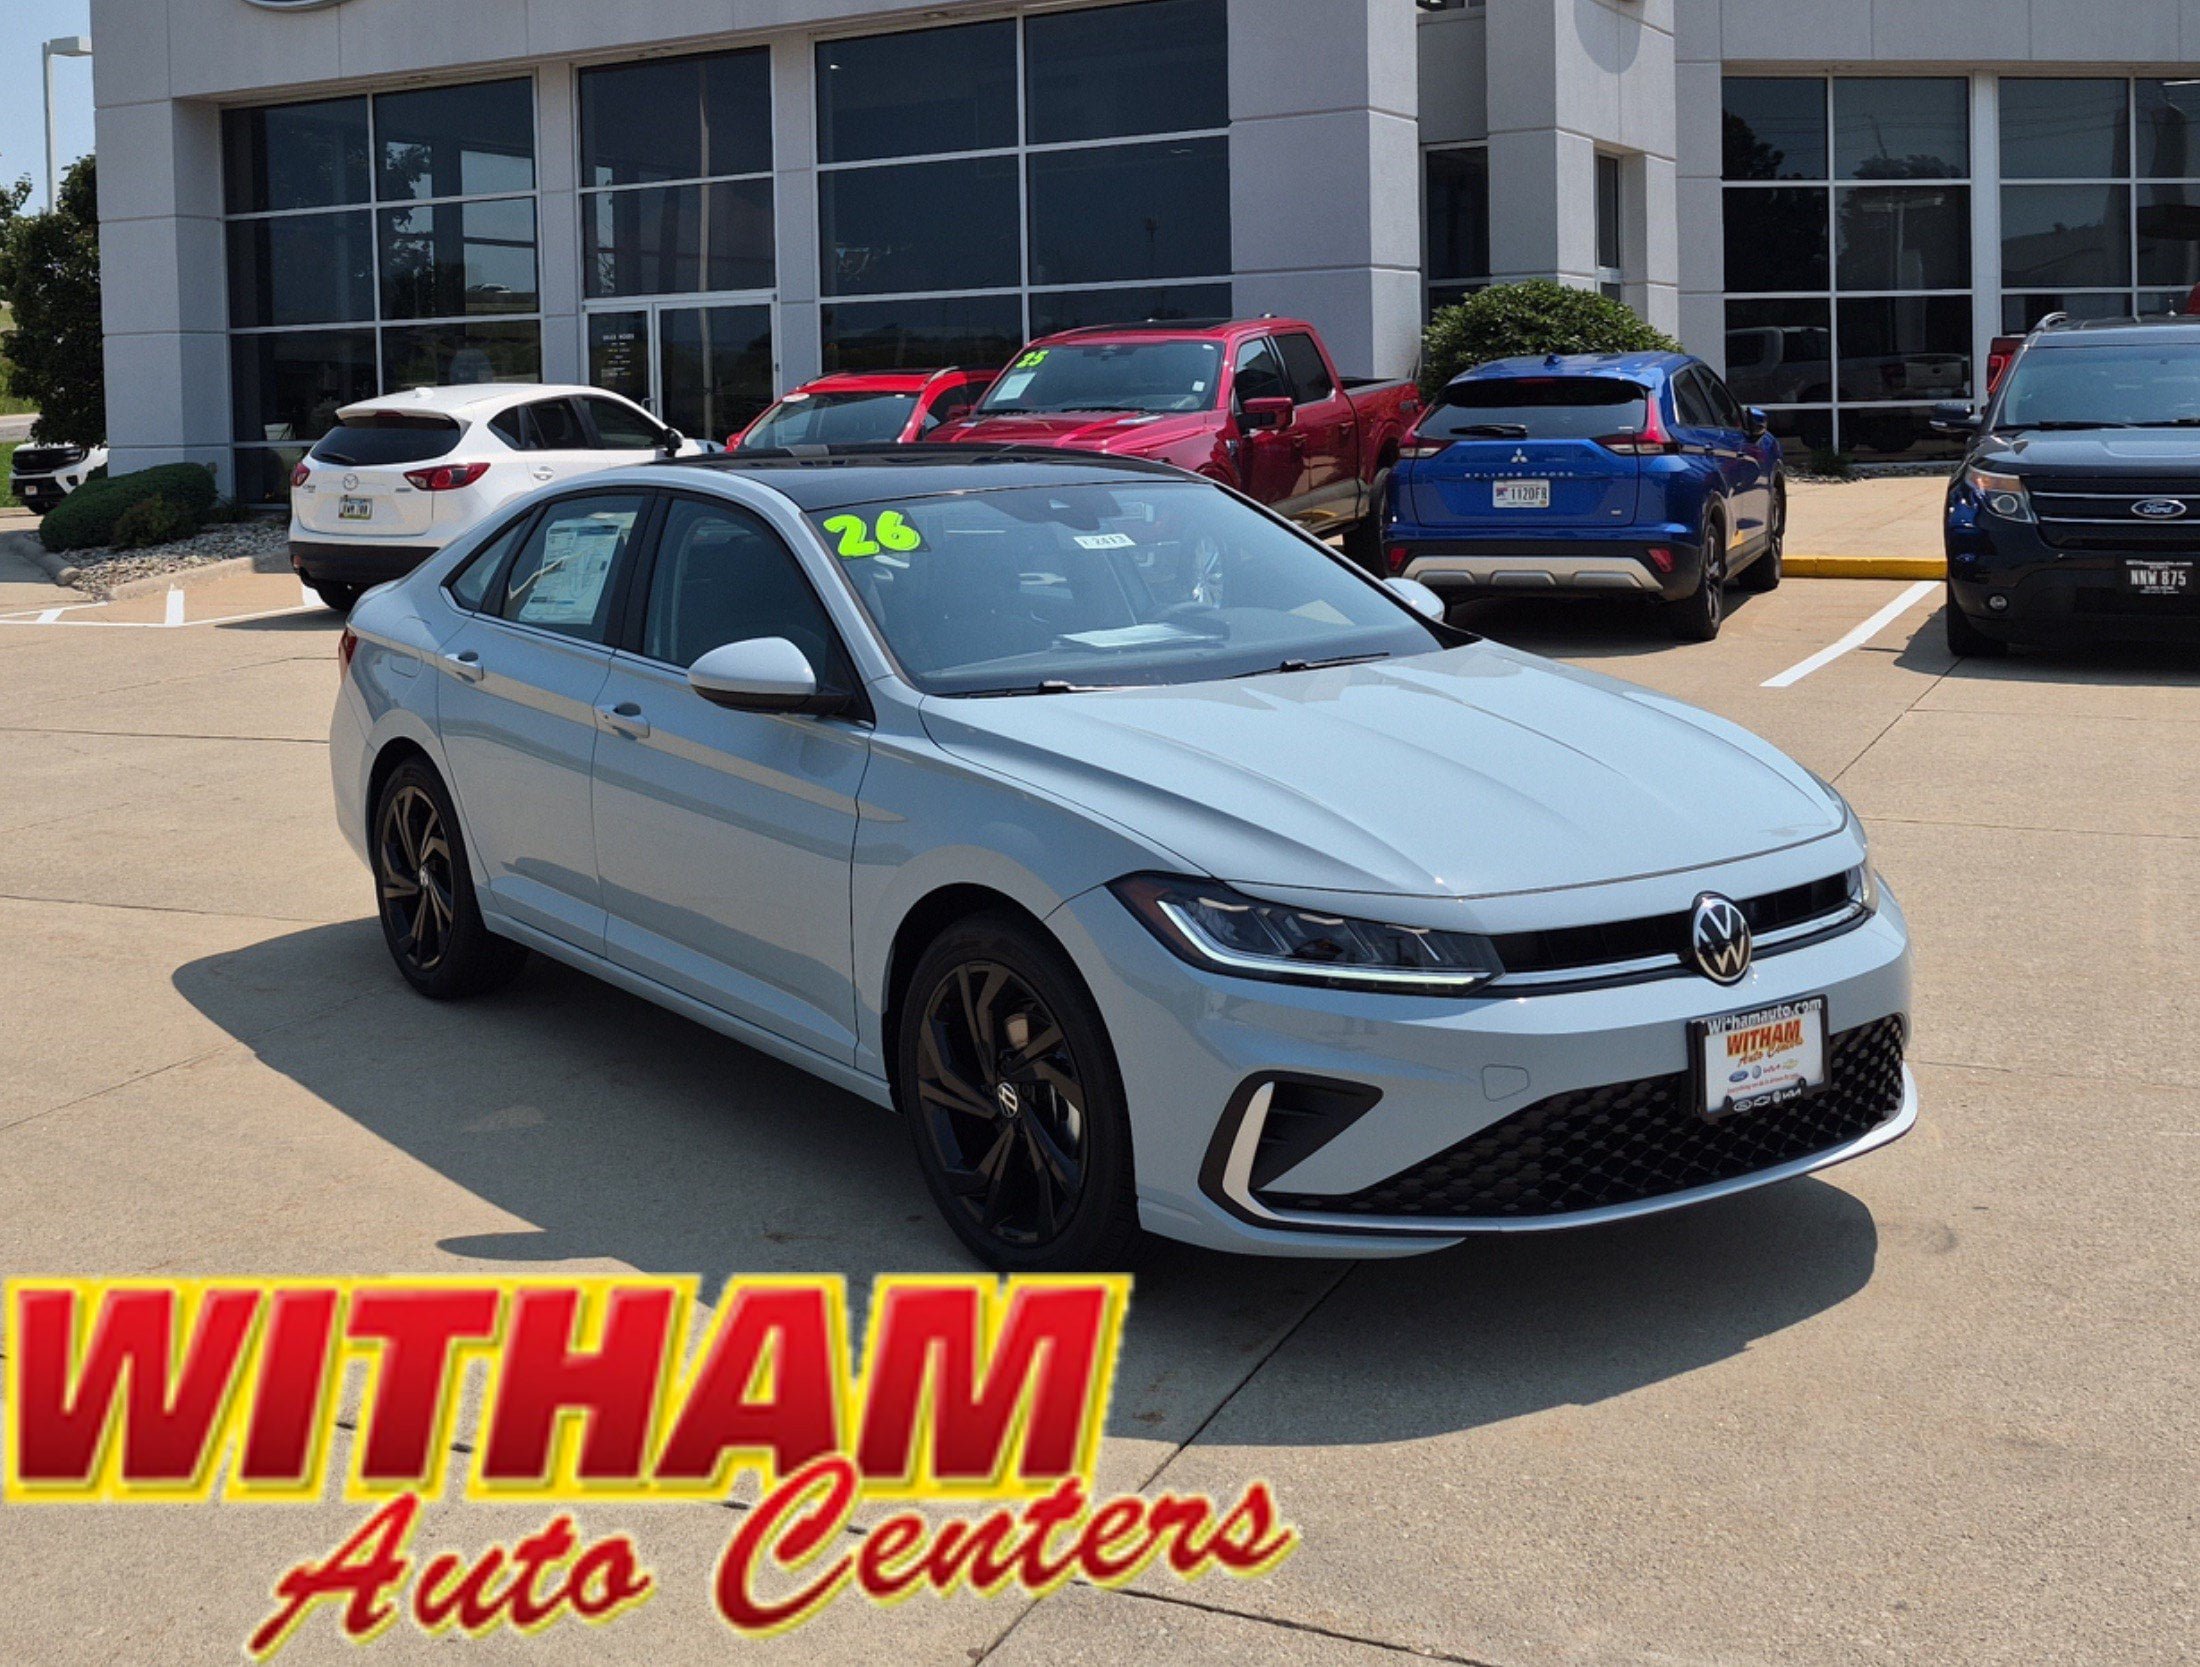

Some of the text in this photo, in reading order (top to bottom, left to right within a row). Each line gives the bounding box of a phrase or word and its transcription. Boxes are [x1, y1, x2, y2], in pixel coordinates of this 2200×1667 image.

[1015, 349, 1051, 369] 25
[2143, 503, 2174, 514] Ford
[823, 510, 921, 557] 26
[2161, 570, 2187, 587] 875
[1727, 1019, 1802, 1058] WITHAM
